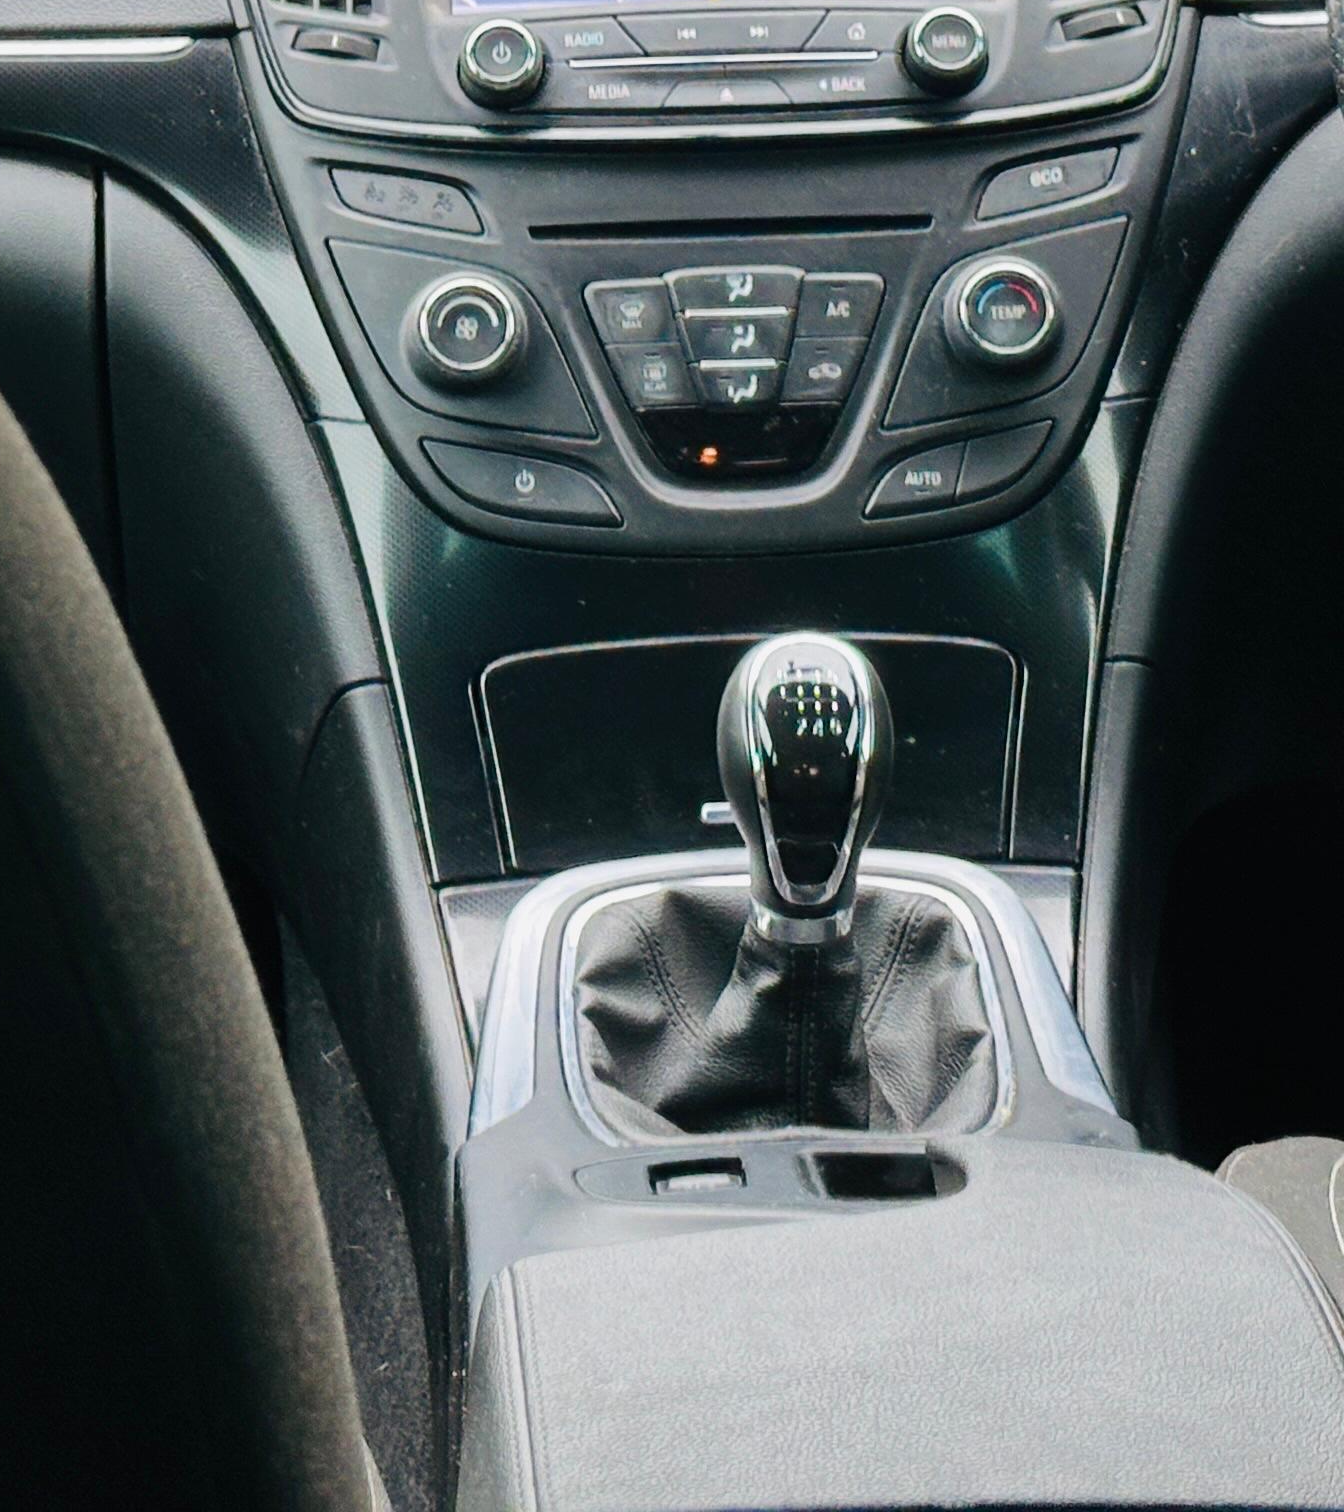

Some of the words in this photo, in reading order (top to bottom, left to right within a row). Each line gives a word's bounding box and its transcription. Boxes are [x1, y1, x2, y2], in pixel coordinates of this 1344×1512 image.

[564, 32, 604, 47] RADIO
[931, 34, 967, 49] MENU
[588, 83, 631, 100] MEDIA
[831, 76, 866, 92] BACK
[825, 301, 851, 318] A/C
[991, 304, 1027, 320] TEMP
[904, 470, 942, 486] AUTO
